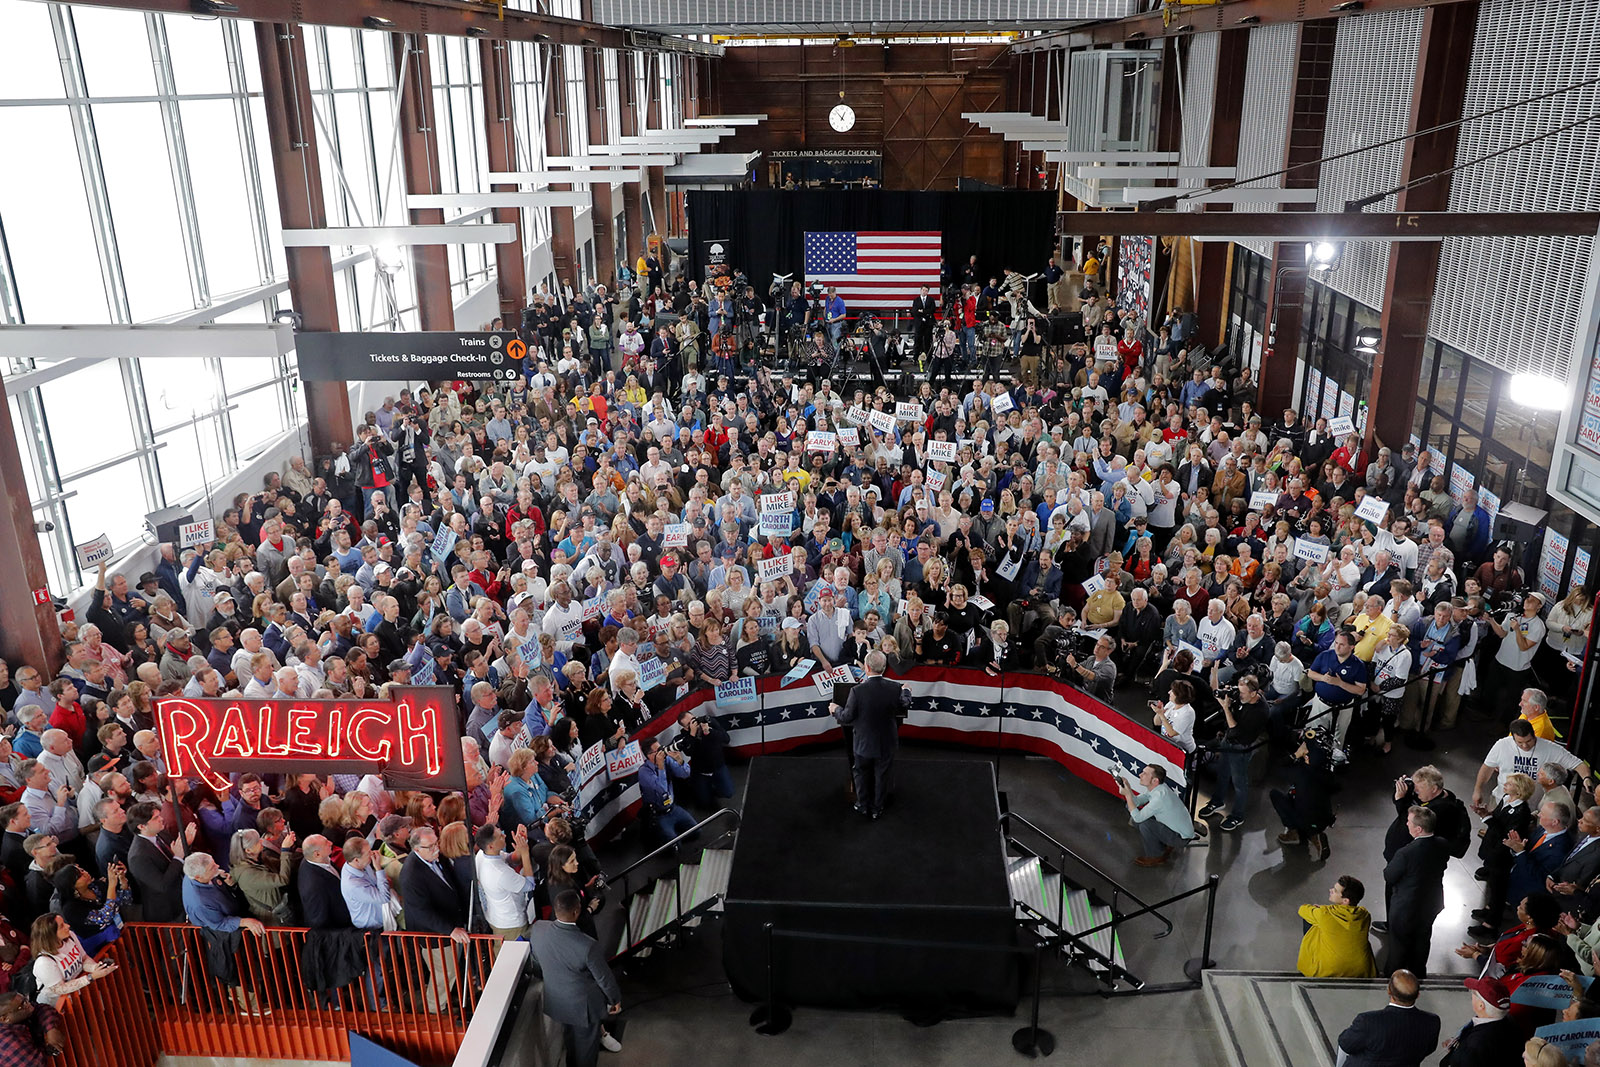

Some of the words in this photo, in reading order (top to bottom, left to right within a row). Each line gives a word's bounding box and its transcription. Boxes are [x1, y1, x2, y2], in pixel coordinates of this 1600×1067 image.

[459, 338, 486, 346] Trains
[370, 354, 400, 362] Tickets
[402, 354, 408, 362] &
[410, 354, 448, 364] Baggage
[450, 354, 487, 362] Check-In
[996, 402, 1010, 410] mike
[850, 413, 868, 424] MIKE
[856, 410, 870, 420] LIKE
[878, 412, 892, 423] LIKE
[872, 417, 890, 430] MIKE
[1334, 424, 1350, 433] mike
[1579, 425, 1600, 446] EARLY
[809, 438, 834, 446] EARLY!
[936, 442, 952, 450] LIKE
[931, 449, 952, 457] MIKE
[927, 476, 942, 487] RLY!
[766, 496, 768, 504] I
[770, 494, 788, 502] LIKE
[766, 501, 789, 511] MIKE
[1360, 506, 1380, 519] mike
[762, 514, 790, 524] NORTH
[184, 526, 188, 534] I
[189, 522, 209, 533] LIKE
[669, 525, 684, 533] VOTE
[185, 530, 210, 542] MIKE
[432, 525, 447, 552] NORTH
[1553, 533, 1568, 547] VOTE
[86, 548, 109, 563] mike
[1298, 548, 1322, 560] mike
[1578, 550, 1591, 562] VOT
[763, 562, 766, 570] I
[768, 556, 788, 568] LIKE
[1550, 556, 1562, 569] VOTE
[1575, 557, 1588, 572] EARL
[764, 564, 788, 578] MIKE
[1545, 578, 1558, 592] VOTE
[804, 582, 824, 605] VOTE
[584, 607, 600, 616] EAR
[562, 618, 580, 632] mike
[660, 622, 670, 630] LIK
[565, 628, 582, 641] 2020
[636, 652, 652, 662] EAR
[640, 658, 662, 674] NORTH
[824, 668, 846, 680] LIKE
[718, 679, 752, 692] NORTH
[822, 674, 850, 690] MIKE
[718, 689, 753, 699] CAROLINA
[158, 700, 440, 791] RALEIGH
[583, 744, 599, 764] LIKE
[611, 744, 636, 760] VOTE
[582, 754, 600, 776] MIKE
[610, 754, 642, 772] EARLY!
[1514, 756, 1538, 766] MIKE
[60, 960, 66, 970] I
[64, 958, 82, 978] MIK
[1547, 984, 1574, 992] CAROL
[1560, 1031, 1600, 1042] CAROLINA
